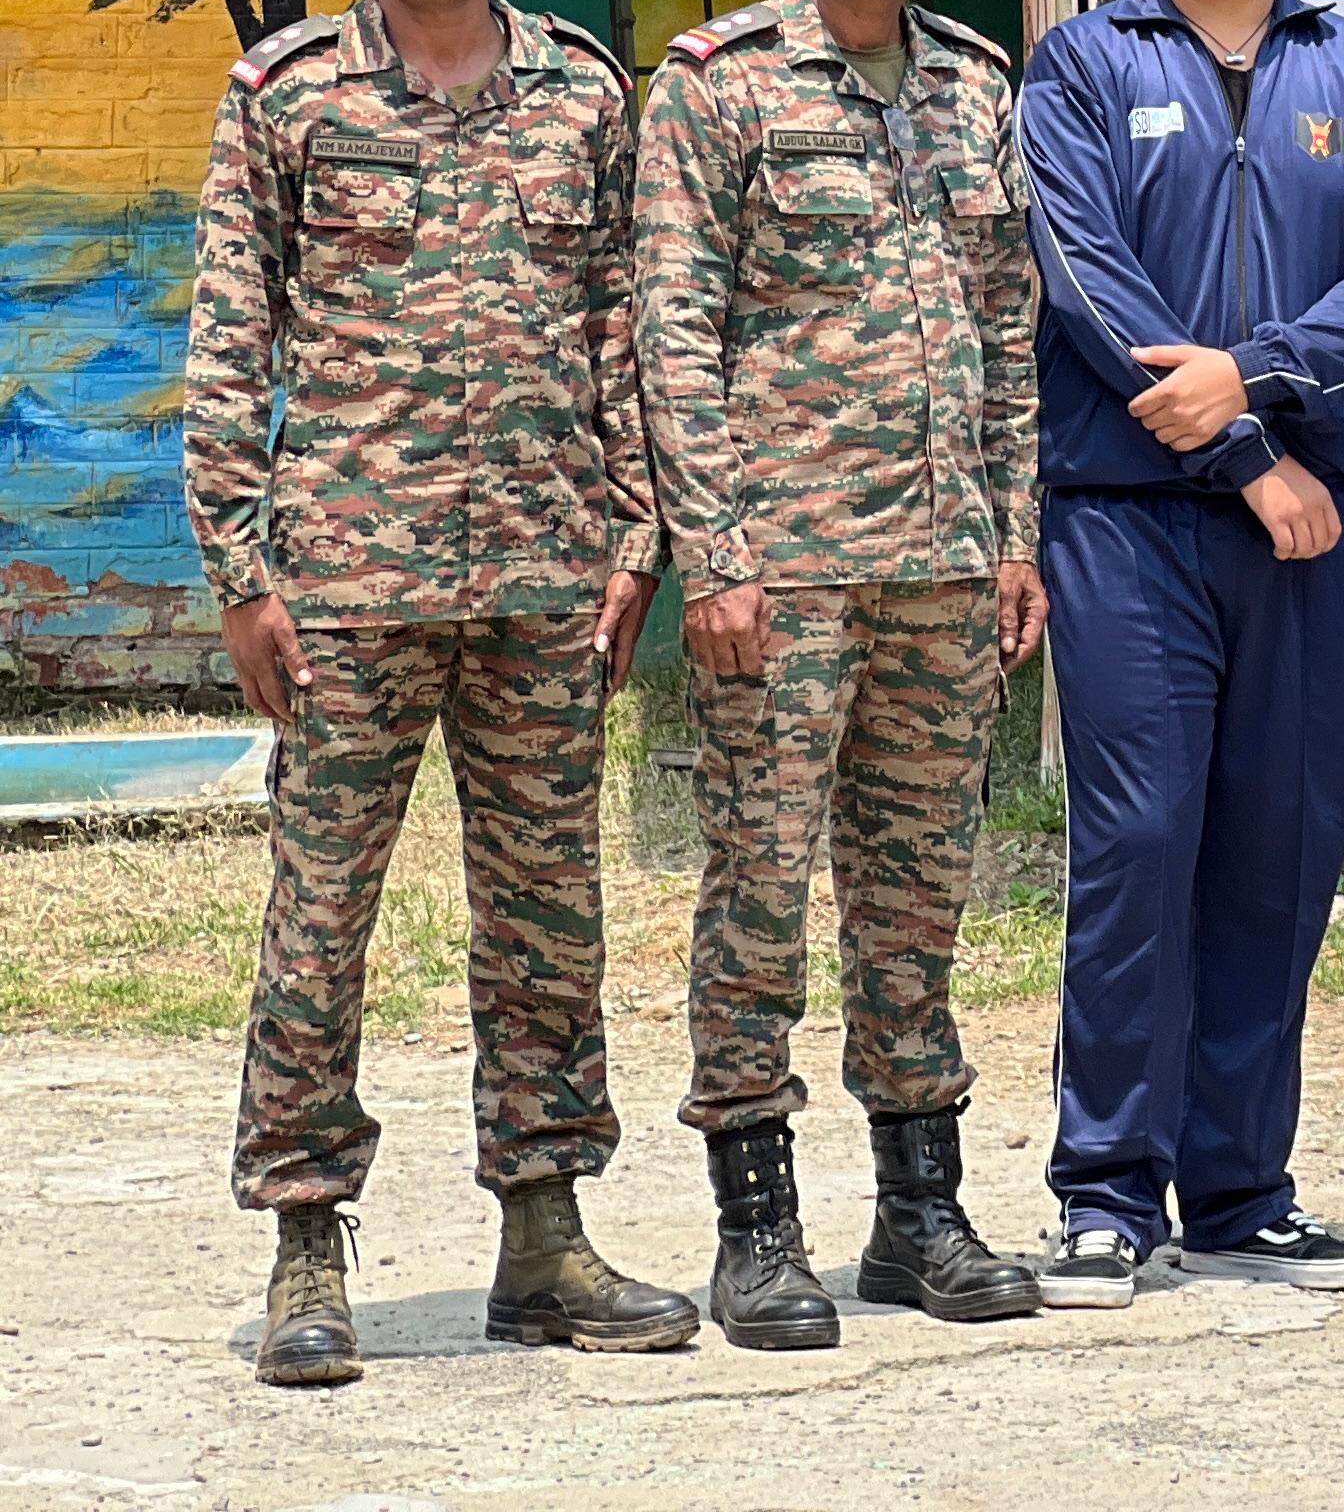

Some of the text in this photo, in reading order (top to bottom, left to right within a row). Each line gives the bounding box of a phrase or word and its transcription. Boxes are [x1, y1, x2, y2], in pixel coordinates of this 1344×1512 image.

[315, 140, 414, 159] NM RAMAJEYAM
[776, 135, 811, 147] ABDUL
[812, 136, 847, 149] SALAM
